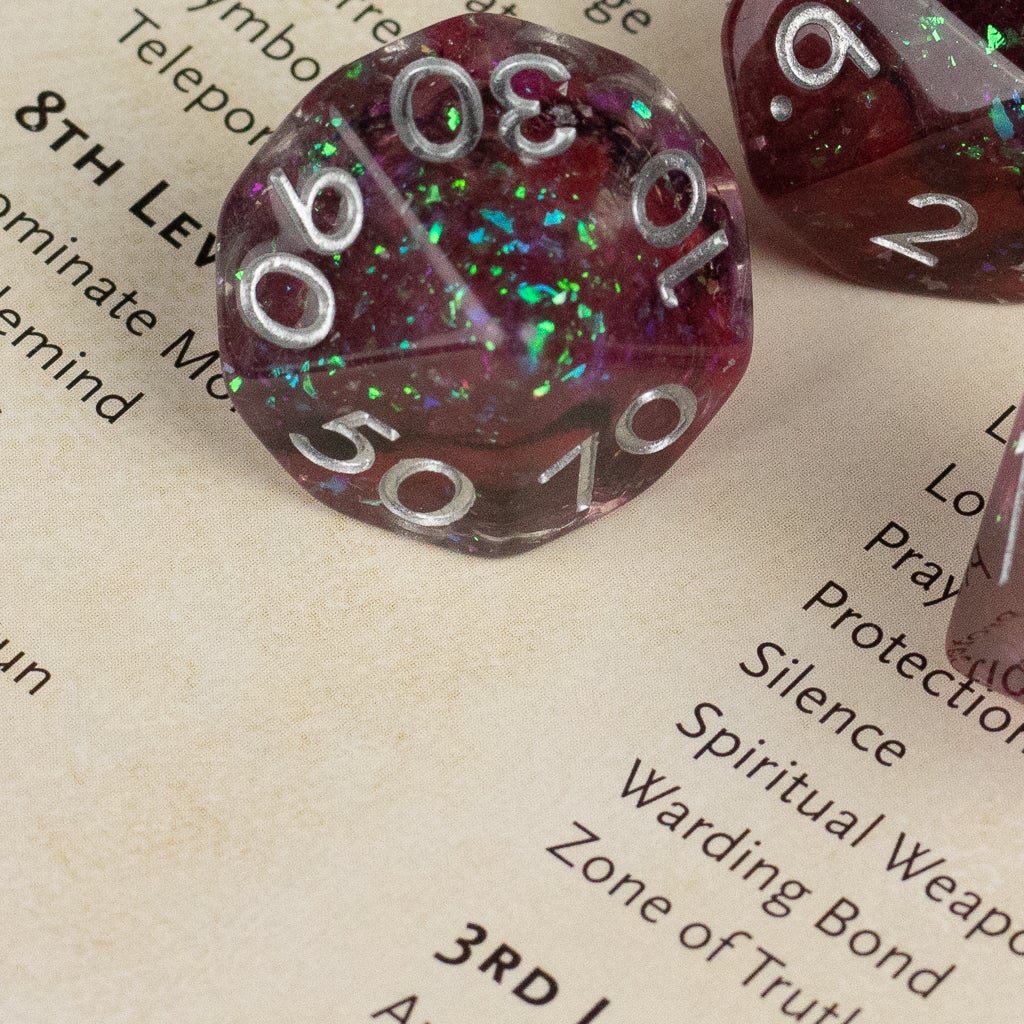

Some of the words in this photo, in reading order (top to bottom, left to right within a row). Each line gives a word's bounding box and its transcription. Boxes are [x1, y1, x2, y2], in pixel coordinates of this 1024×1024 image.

[117, 6, 276, 147] Telepor
[390, 52, 578, 164] 30
[14, 89, 126, 188] 8TH
[128, 178, 218, 270] LEV
[869, 191, 979, 268] 2
[290, 410, 477, 527] 50
[538, 383, 699, 512] 70
[863, 520, 960, 610] Pray
[738, 641, 908, 769] Silence
[676, 701, 886, 849] Spiritual
[545, 820, 673, 925] Zone
[678, 921, 754, 964] of
[618, 757, 814, 919] Warding
[813, 896, 957, 999] Bond
[433, 921, 560, 1008] 3RD
